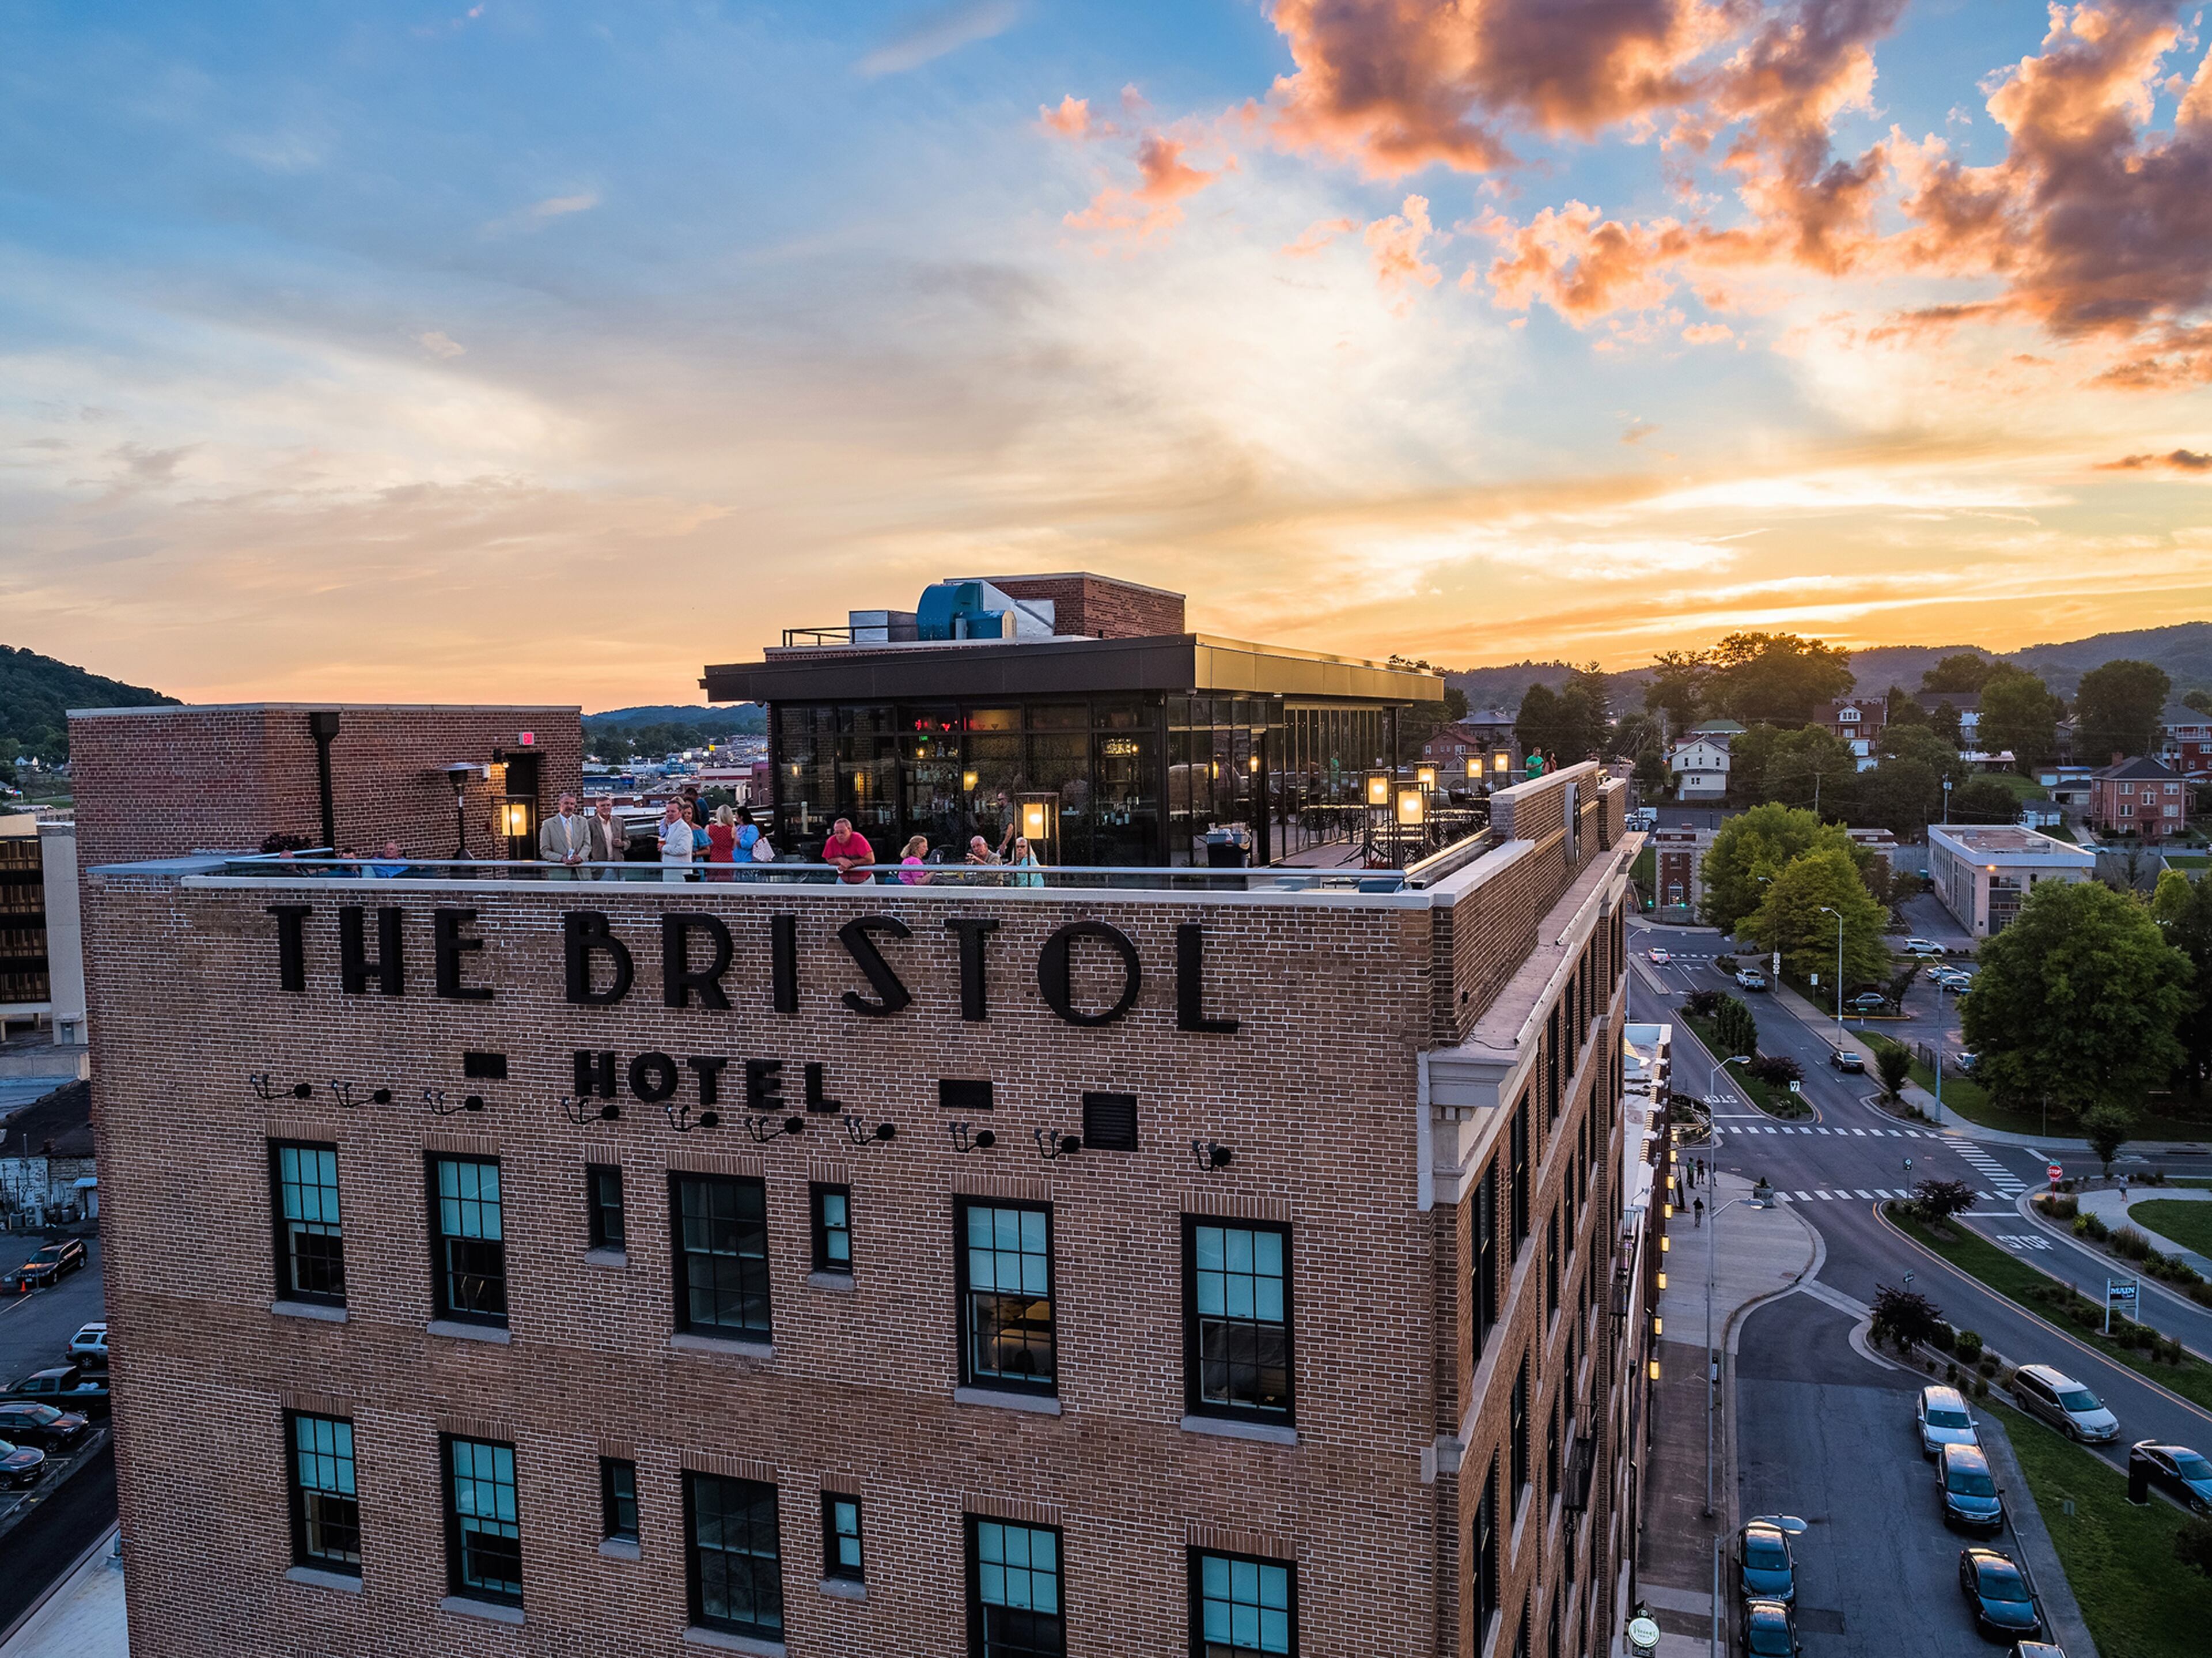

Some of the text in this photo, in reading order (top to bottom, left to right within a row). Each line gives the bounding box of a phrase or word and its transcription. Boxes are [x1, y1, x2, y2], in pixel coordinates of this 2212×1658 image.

[267, 904, 1240, 1034] THE BRISTOL
[574, 1049, 841, 1113] HOTEL
[1703, 1094, 1738, 1104] STOP
[1996, 1235, 2054, 1250] STOP
[2111, 1286, 2135, 1294] MAIN
